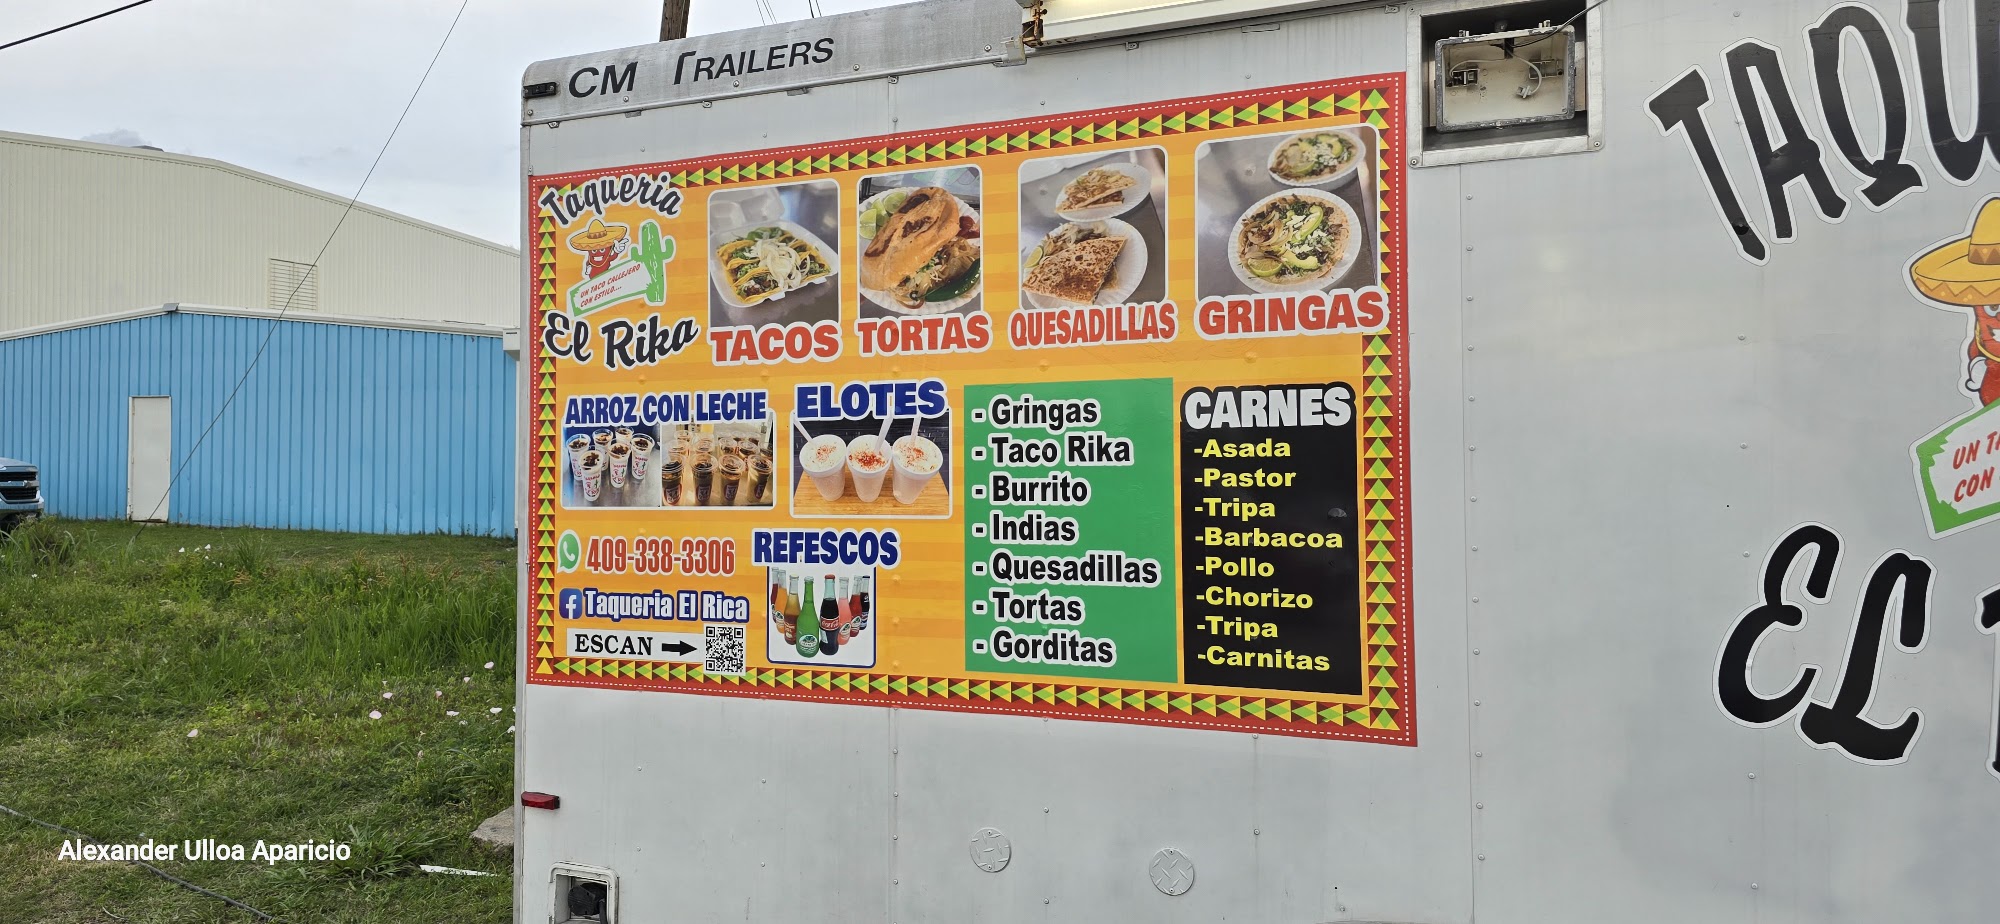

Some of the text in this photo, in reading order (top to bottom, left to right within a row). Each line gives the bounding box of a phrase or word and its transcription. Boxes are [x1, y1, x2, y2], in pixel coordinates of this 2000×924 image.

[568, 61, 638, 98] CM
[541, 174, 681, 225] Taqueria
[1009, 303, 1176, 347] QUESADILLAS
[1200, 292, 1383, 335] GRINGAS
[545, 315, 698, 369] El Rika
[711, 327, 839, 362] TACOS
[858, 316, 989, 354] TORTAS
[565, 391, 767, 425] ARROZ CON LECHE
[797, 380, 945, 418] ELOTES
[993, 397, 1097, 430] Gringas
[1185, 387, 1351, 429] CARNES
[992, 437, 1058, 463] Taco
[1068, 435, 1130, 462] Rika
[1194, 438, 1291, 458] -Asada
[1952, 440, 1980, 469] UN
[993, 474, 1088, 502] Burrito
[1194, 469, 1296, 488] -Pastor
[1954, 466, 1995, 502] CON
[1195, 498, 1275, 521] -Tripa
[993, 514, 1076, 541] Indias
[1195, 528, 1342, 548] -Barbacoa
[587, 538, 735, 575] 409-338-3306
[754, 531, 898, 565] REFESCOS
[993, 553, 1158, 584] Quesadillas
[1195, 557, 1275, 577] -Pollo
[585, 591, 747, 621] Taqueria El Rica
[993, 592, 1082, 621] Tortas
[1196, 586, 1313, 609] -Chorizo
[1197, 616, 1278, 641] -Tripa
[1718, 525, 1931, 760] EL
[575, 634, 653, 656] ESCAN
[993, 631, 1113, 664] Gorditas
[1198, 645, 1330, 672] -Carnitas
